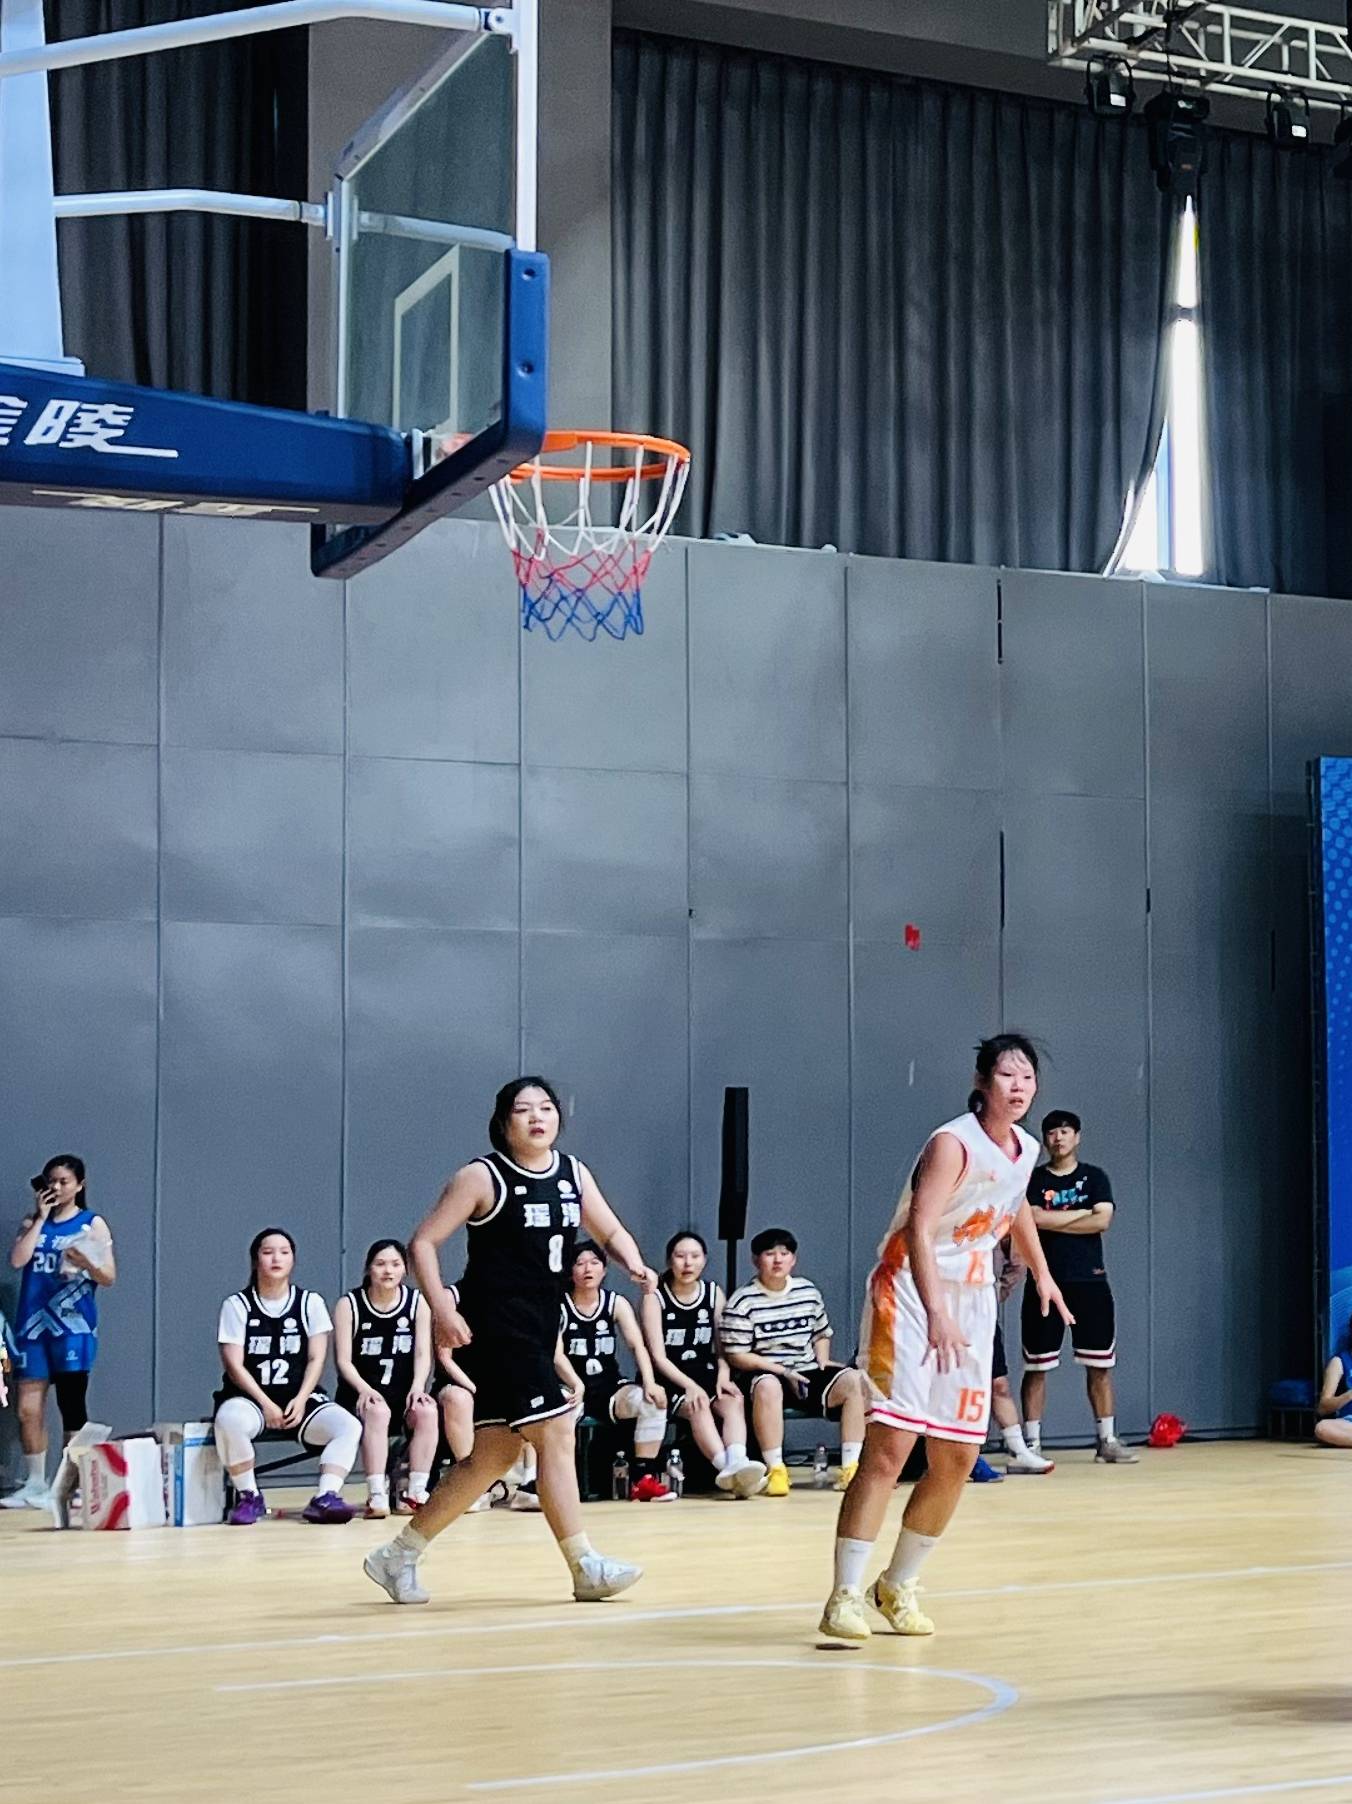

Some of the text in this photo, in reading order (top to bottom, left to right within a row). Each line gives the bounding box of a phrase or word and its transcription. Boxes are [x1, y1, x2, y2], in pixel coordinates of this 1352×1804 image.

[33, 1251, 57, 1274] 20
[257, 1358, 290, 1386] 12
[379, 1358, 395, 1386] 7
[957, 1387, 986, 1424] 15
